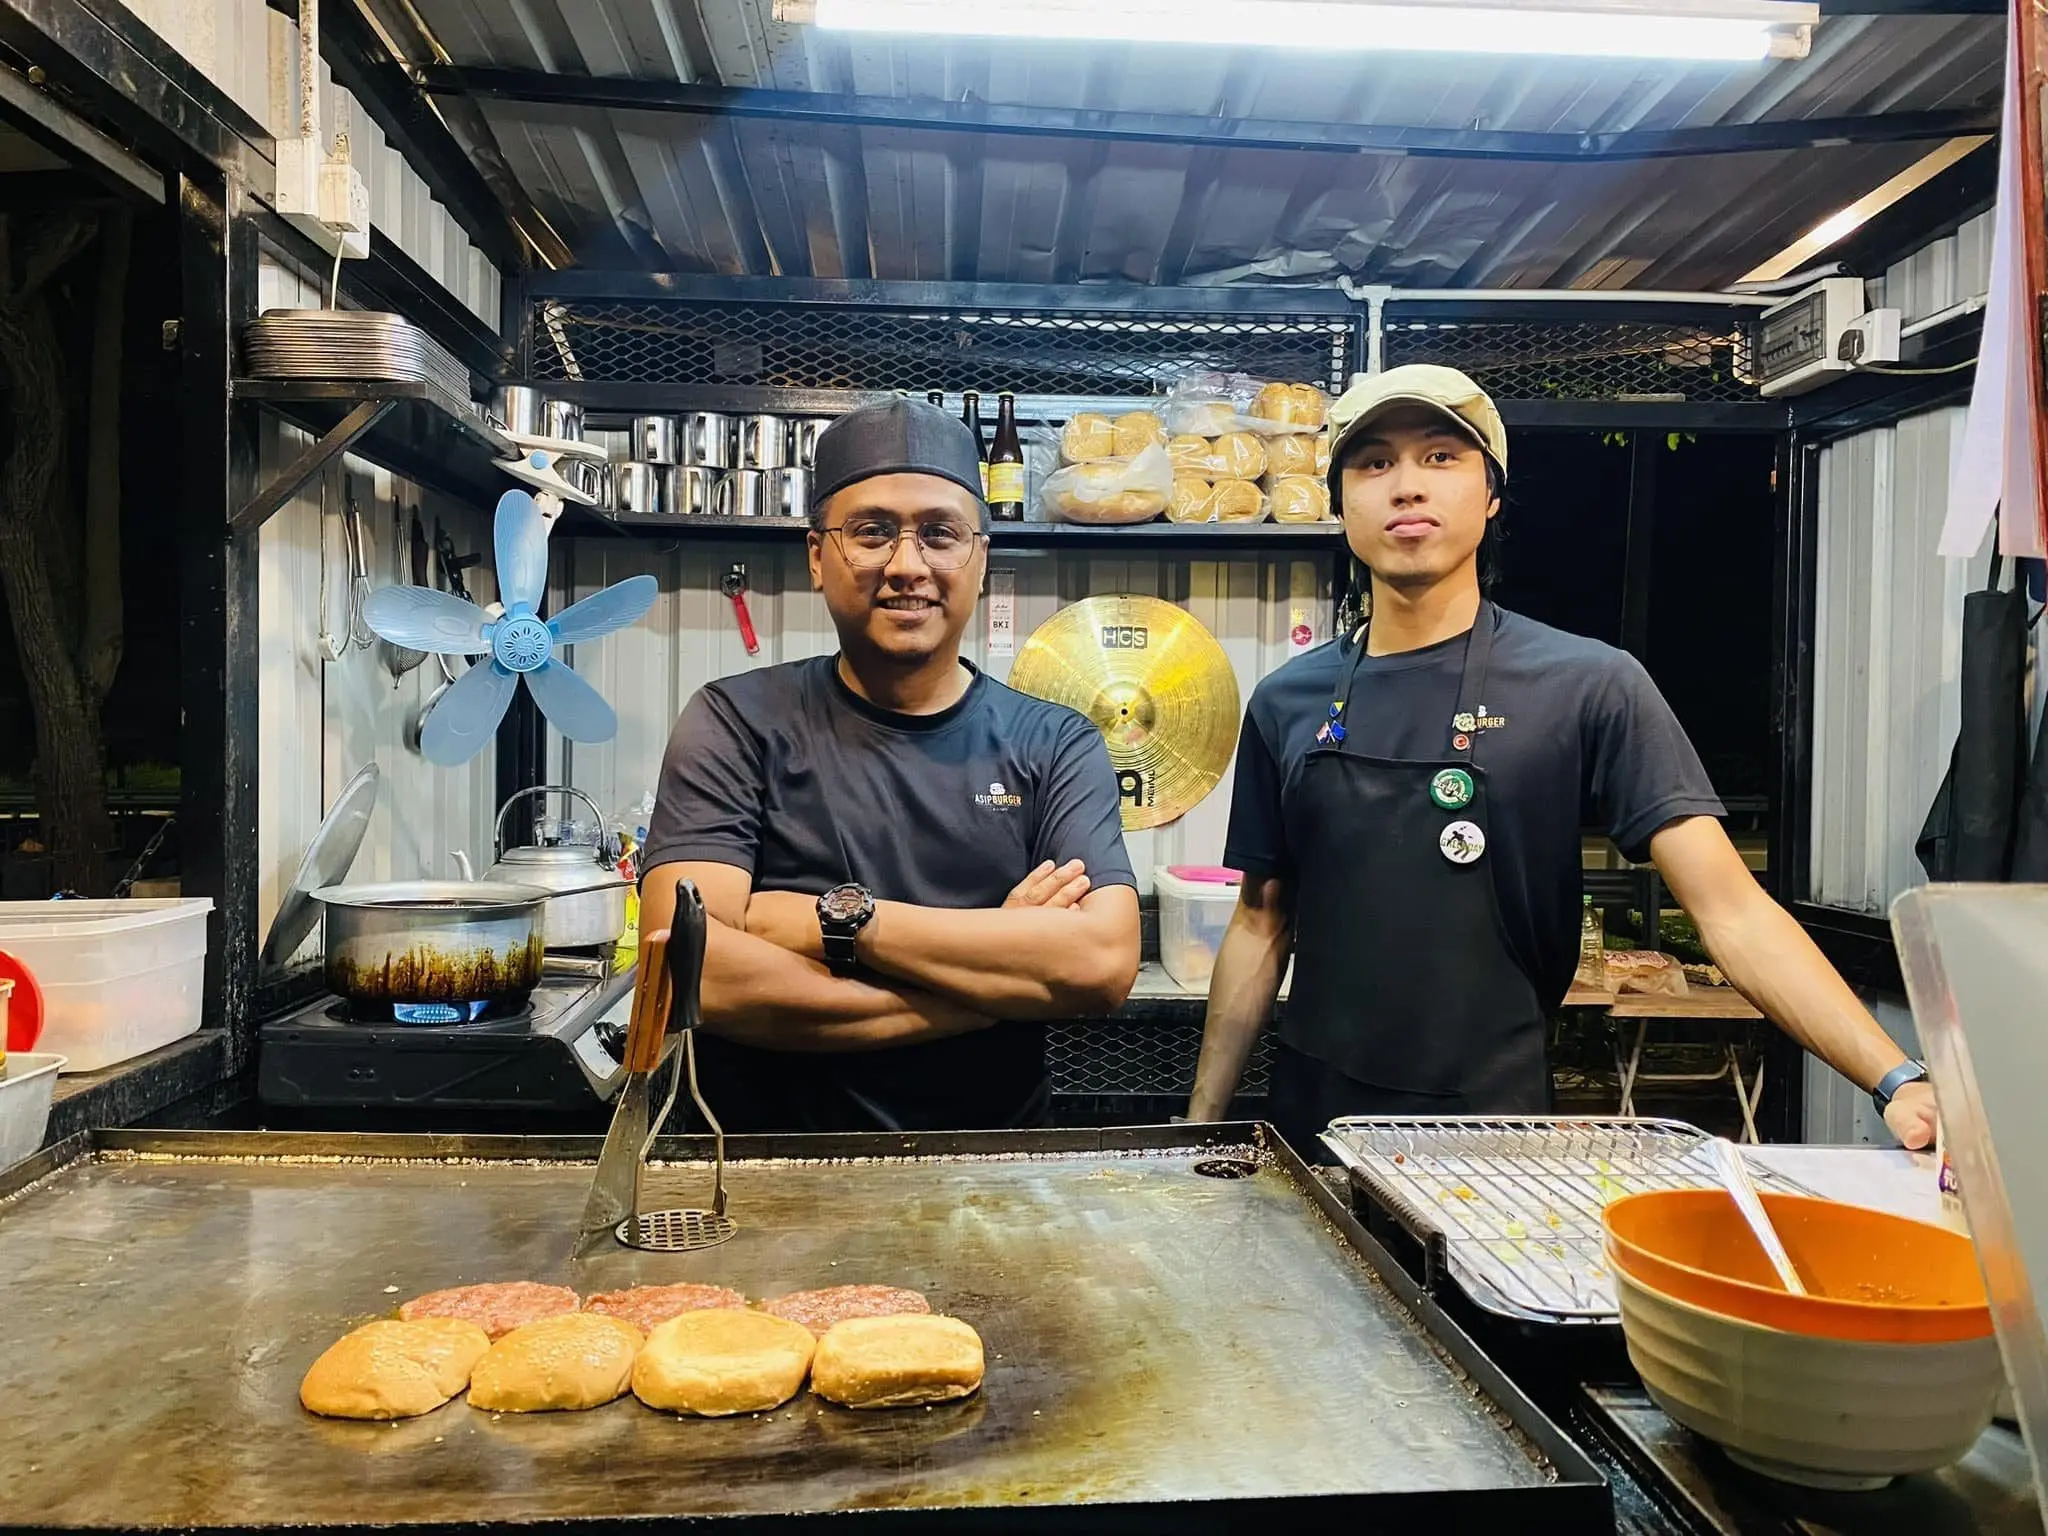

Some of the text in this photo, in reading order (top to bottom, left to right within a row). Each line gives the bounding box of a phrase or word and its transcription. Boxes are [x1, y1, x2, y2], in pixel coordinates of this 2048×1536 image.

[993, 621, 1009, 629] BKI
[1103, 628, 1146, 646] HCS
[1476, 717, 1505, 728] URGER
[974, 794, 1022, 807] ASIPBURGER
